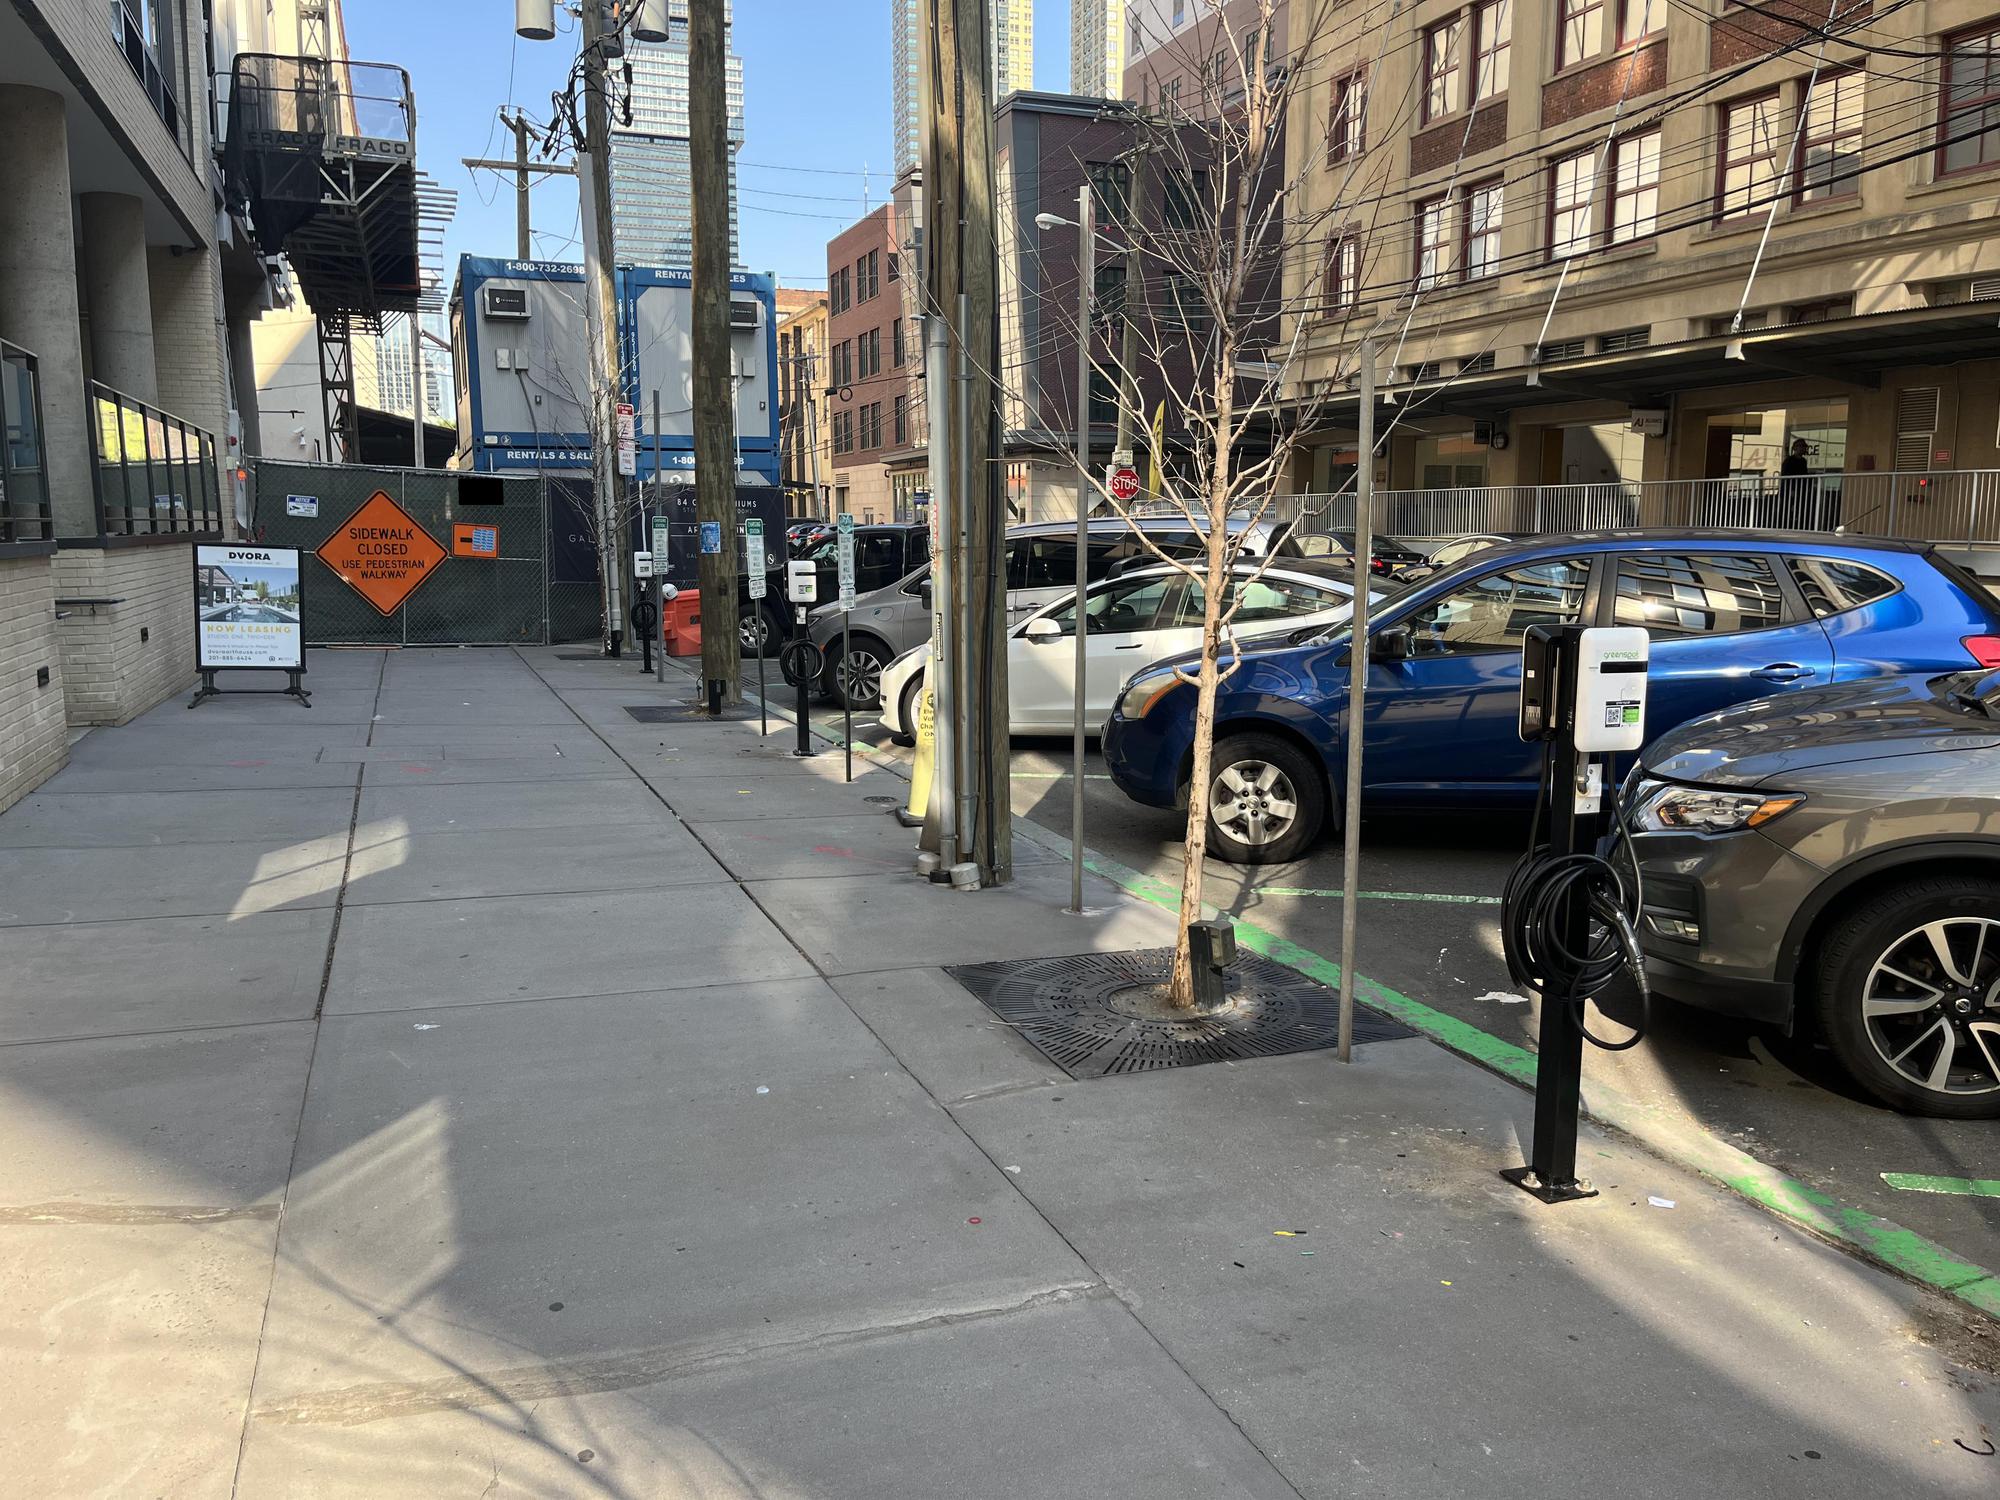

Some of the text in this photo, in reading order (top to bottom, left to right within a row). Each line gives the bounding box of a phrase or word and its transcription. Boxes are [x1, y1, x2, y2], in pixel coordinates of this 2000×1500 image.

[247, 131, 321, 145] FRACO
[335, 136, 407, 155] FRACO
[506, 261, 586, 275] 1-800-732-2698
[655, 270, 692, 280] RENTA
[507, 451, 556, 460] RENTALS
[558, 451, 567, 460] &
[672, 456, 696, 465] 1-80
[1113, 478, 1138, 490] STOP
[350, 528, 414, 540] SIDEWALK
[568, 534, 595, 544] GAL
[358, 543, 408, 555] CLOSED
[228, 551, 271, 560] DVORA
[342, 560, 425, 569] USE PEDESTRIAN
[360, 570, 407, 579] WALKWAY
[207, 624, 291, 633] NOW LEASING
[1604, 651, 1639, 660] greenspot
